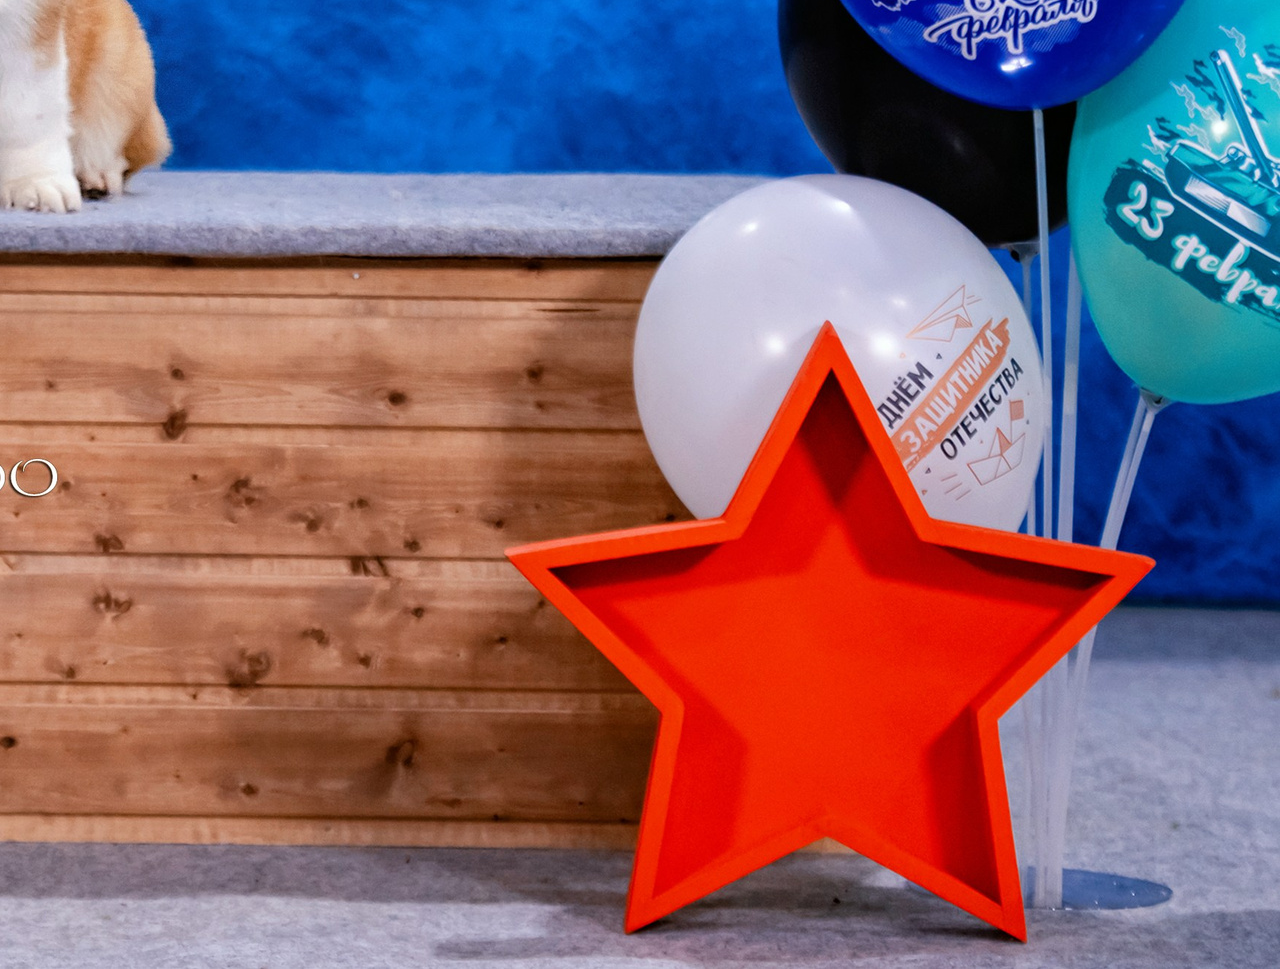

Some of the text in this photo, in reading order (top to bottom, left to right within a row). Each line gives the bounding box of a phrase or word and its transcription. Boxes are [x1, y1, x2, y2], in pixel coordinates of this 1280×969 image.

[1119, 182, 1280, 308] 23 февра
[877, 361, 934, 430] ДНЁМ
[900, 329, 1004, 453] ЗАЩИТНИКА
[939, 357, 1025, 460] ОТЕЧЕСТВА
